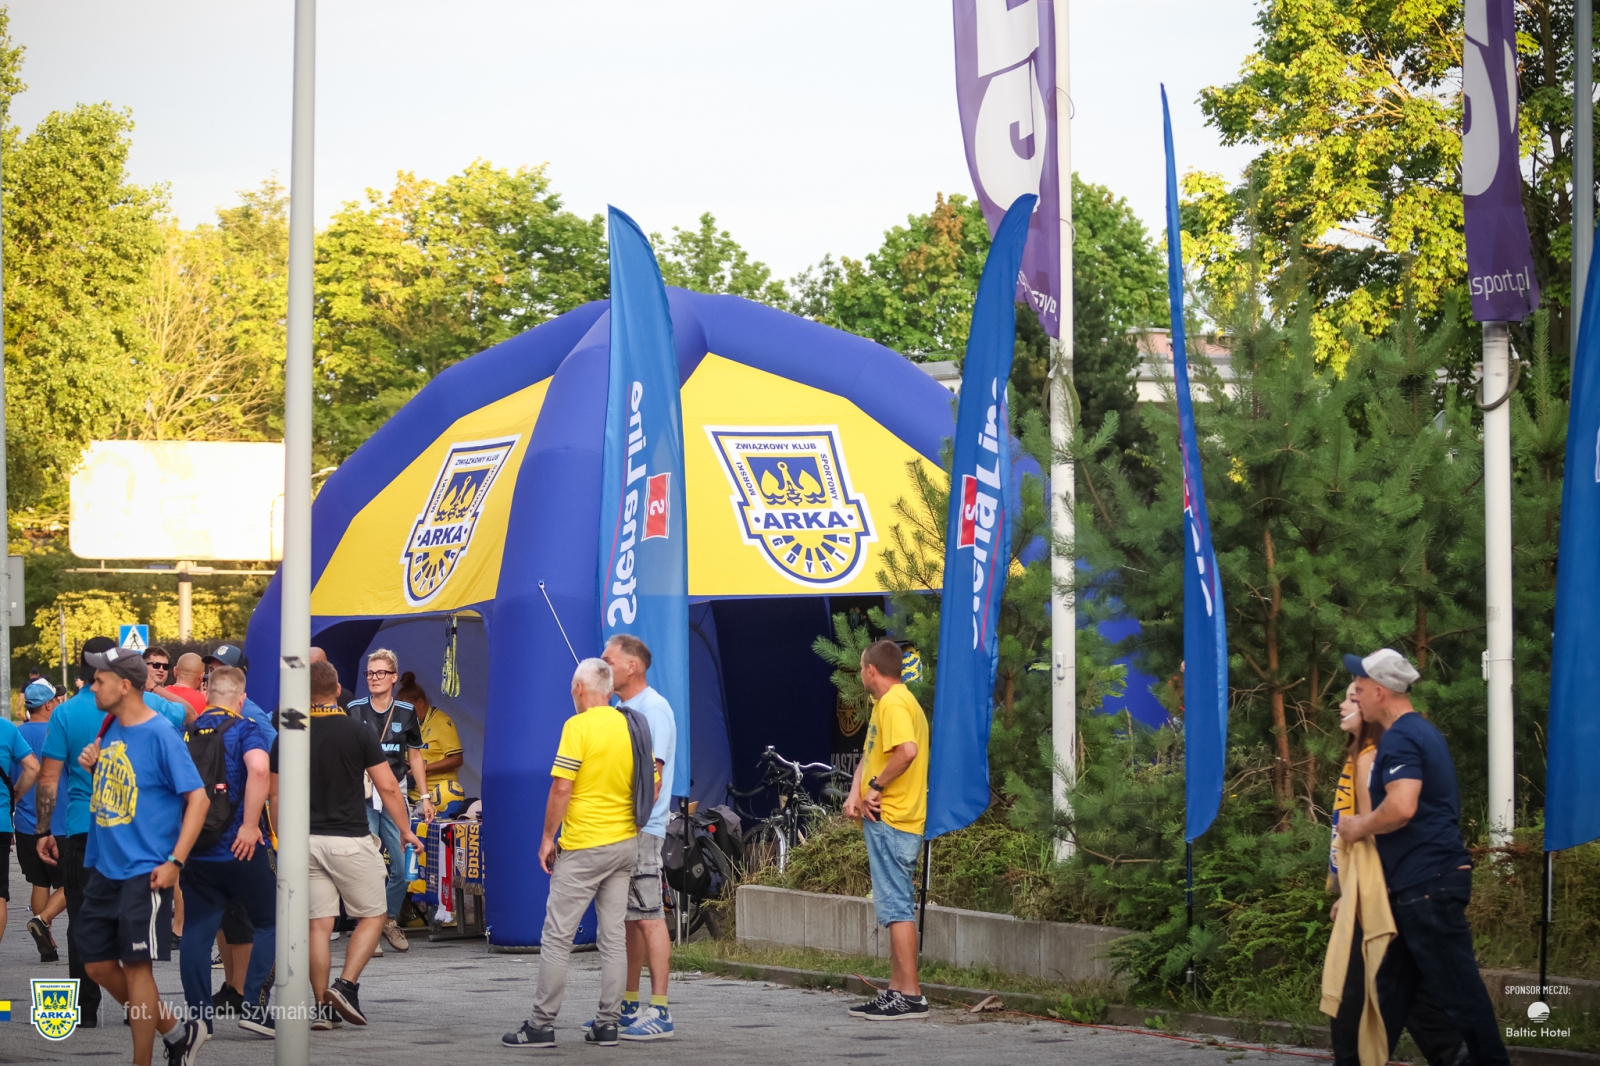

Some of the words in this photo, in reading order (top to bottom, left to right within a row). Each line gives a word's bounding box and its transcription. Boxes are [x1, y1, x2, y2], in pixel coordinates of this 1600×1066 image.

[486, 453, 500, 463] KLUB
[735, 442, 789, 451] ZWIĄZKOWY
[792, 442, 817, 450] KLUB
[735, 462, 757, 496] MORSKI
[820, 453, 839, 501] SPORTOWY
[430, 478, 449, 514] MORSKI
[763, 511, 849, 530] ARKA
[418, 525, 464, 547] ARKA
[772, 535, 851, 573] GDYNIA
[830, 749, 863, 774] KASZË
